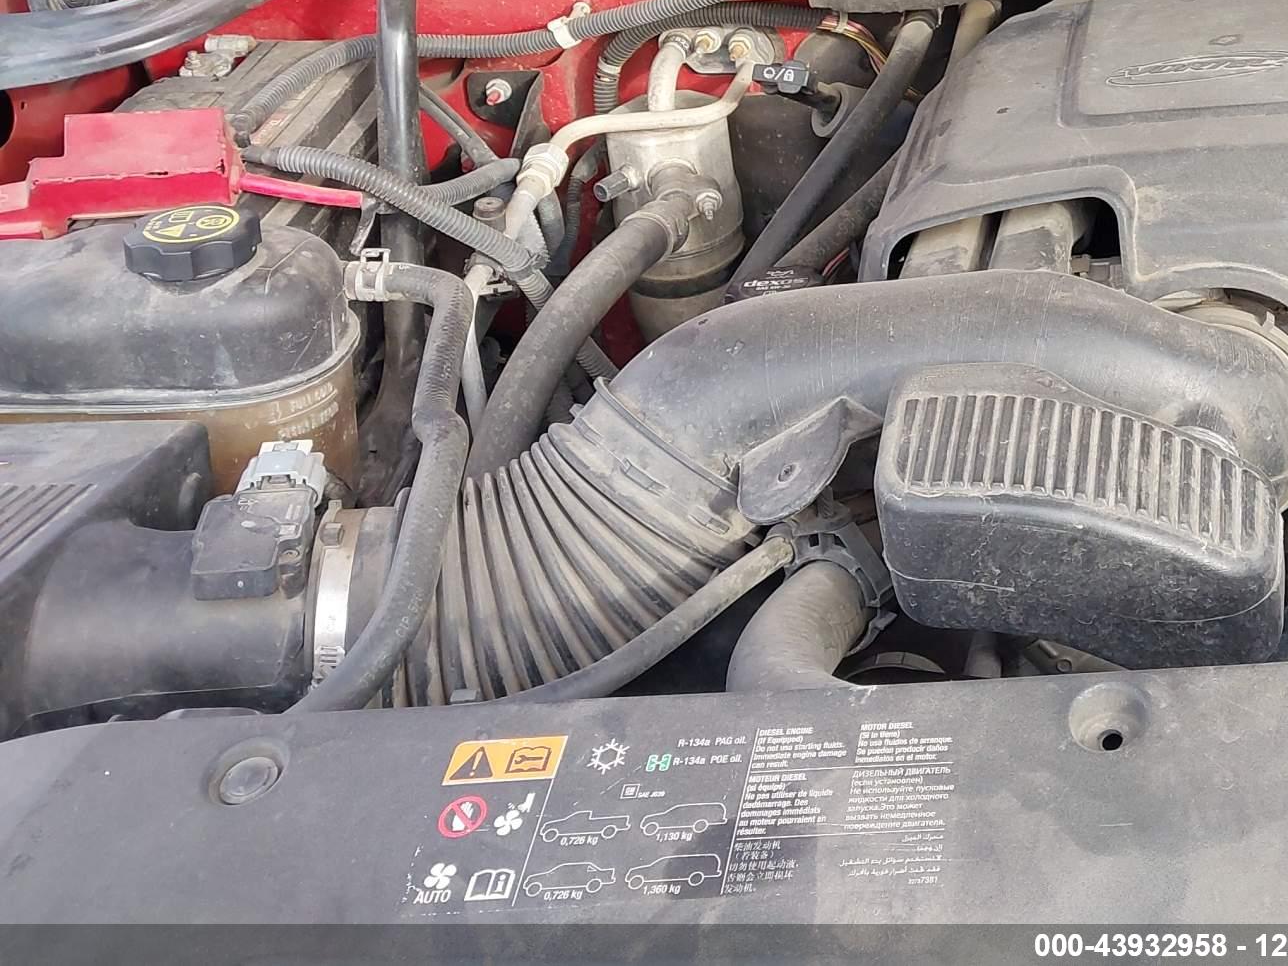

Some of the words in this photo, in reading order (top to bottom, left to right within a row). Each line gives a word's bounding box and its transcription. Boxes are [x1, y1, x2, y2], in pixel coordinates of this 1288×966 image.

[759, 728, 785, 736] DIESEL
[786, 727, 814, 735] ENGINE
[861, 723, 887, 731] MOTOR
[888, 722, 914, 730] DIESEL
[678, 738, 711, 747] R-134a
[714, 737, 733, 746] PAG
[734, 736, 747, 745] oil.
[672, 756, 706, 766] R-134a
[710, 755, 728, 764] POE
[729, 754, 743, 763] oil.
[749, 775, 780, 783] MOTEUR
[781, 773, 807, 782] DIESEL
[560, 835, 585, 846] 0,726
[586, 834, 598, 845] kg
[655, 832, 679, 843] 1,130
[681, 831, 693, 842] kg
[543, 889, 569, 901] 0,726
[570, 889, 583, 900] kg
[643, 884, 667, 895] 1,360
[668, 884, 681, 895] kg
[413, 889, 452, 904] AUTO
